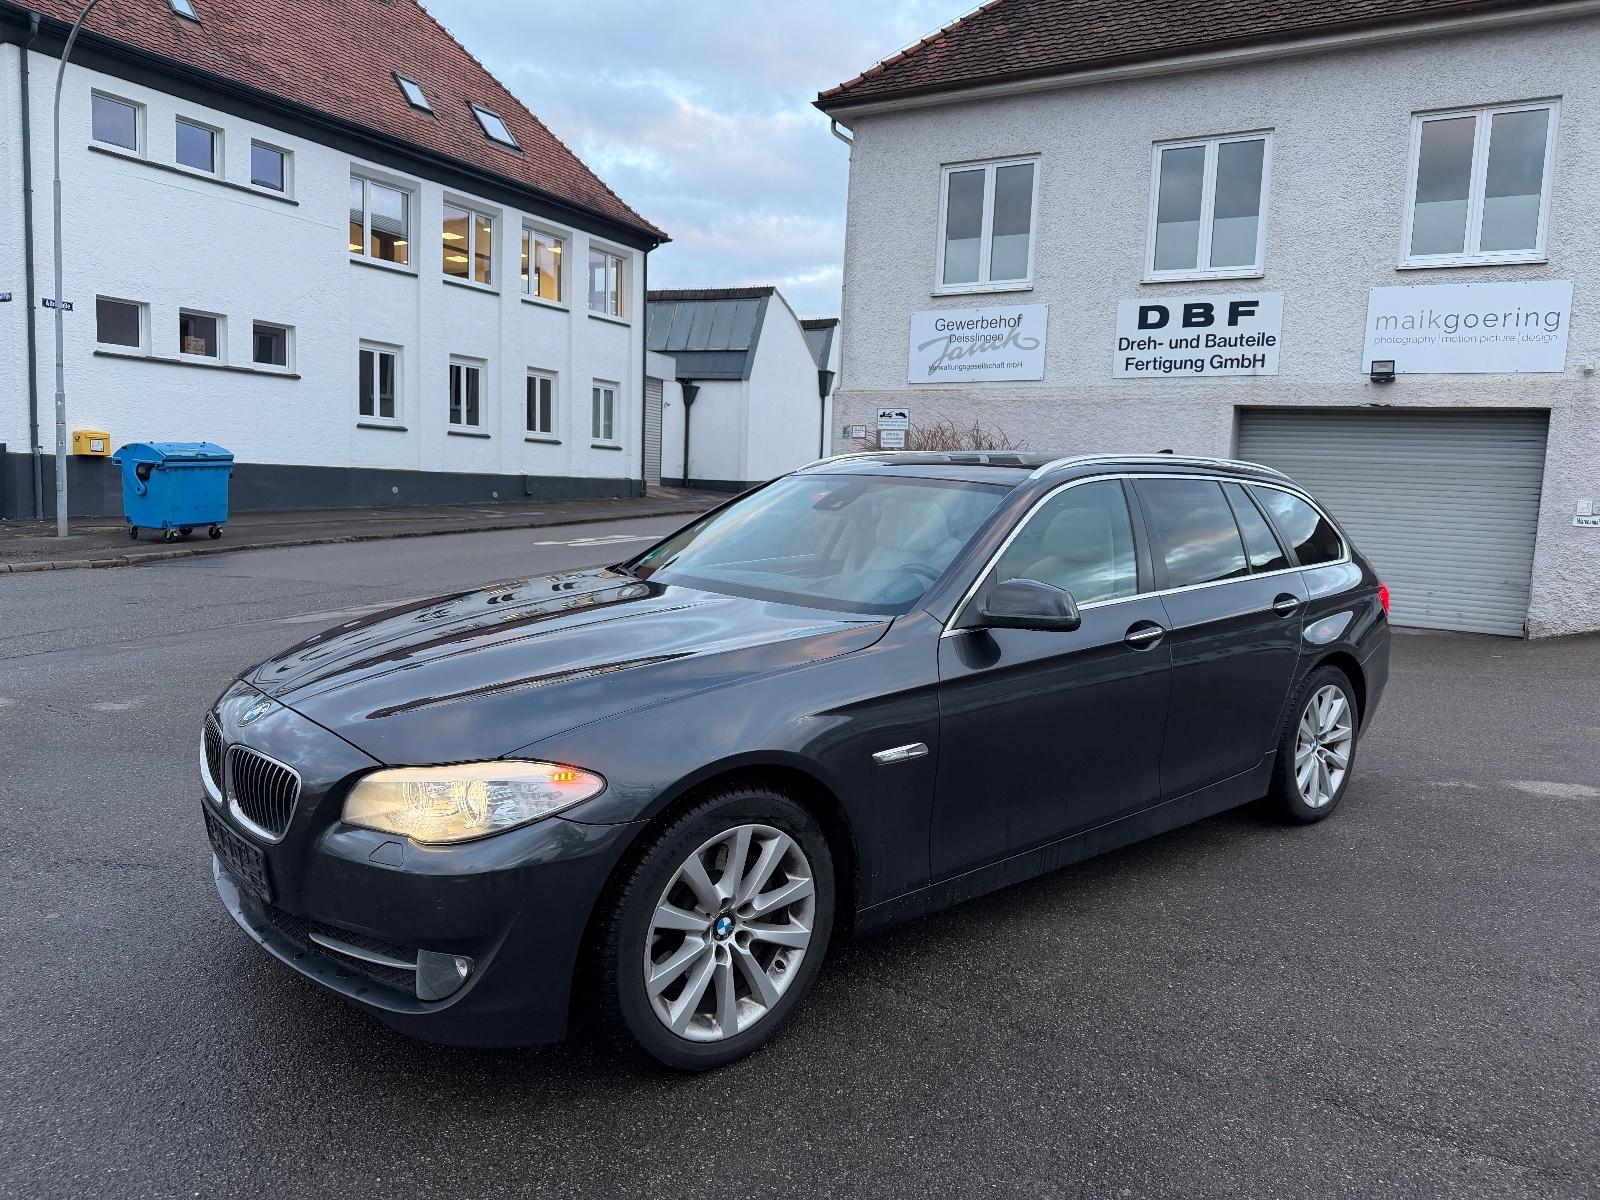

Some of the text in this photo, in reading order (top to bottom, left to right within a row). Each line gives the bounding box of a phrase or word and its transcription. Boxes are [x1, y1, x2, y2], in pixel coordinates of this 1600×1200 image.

[934, 313, 1024, 332] Gewerbehof
[1375, 307, 1561, 334] maikgoering
[949, 332, 1004, 344] Deisslingen
[1118, 332, 1277, 351] Dreh- und Bauteile
[1006, 361, 1023, 369] mbH
[1125, 353, 1266, 373] Fertigung GmbH
